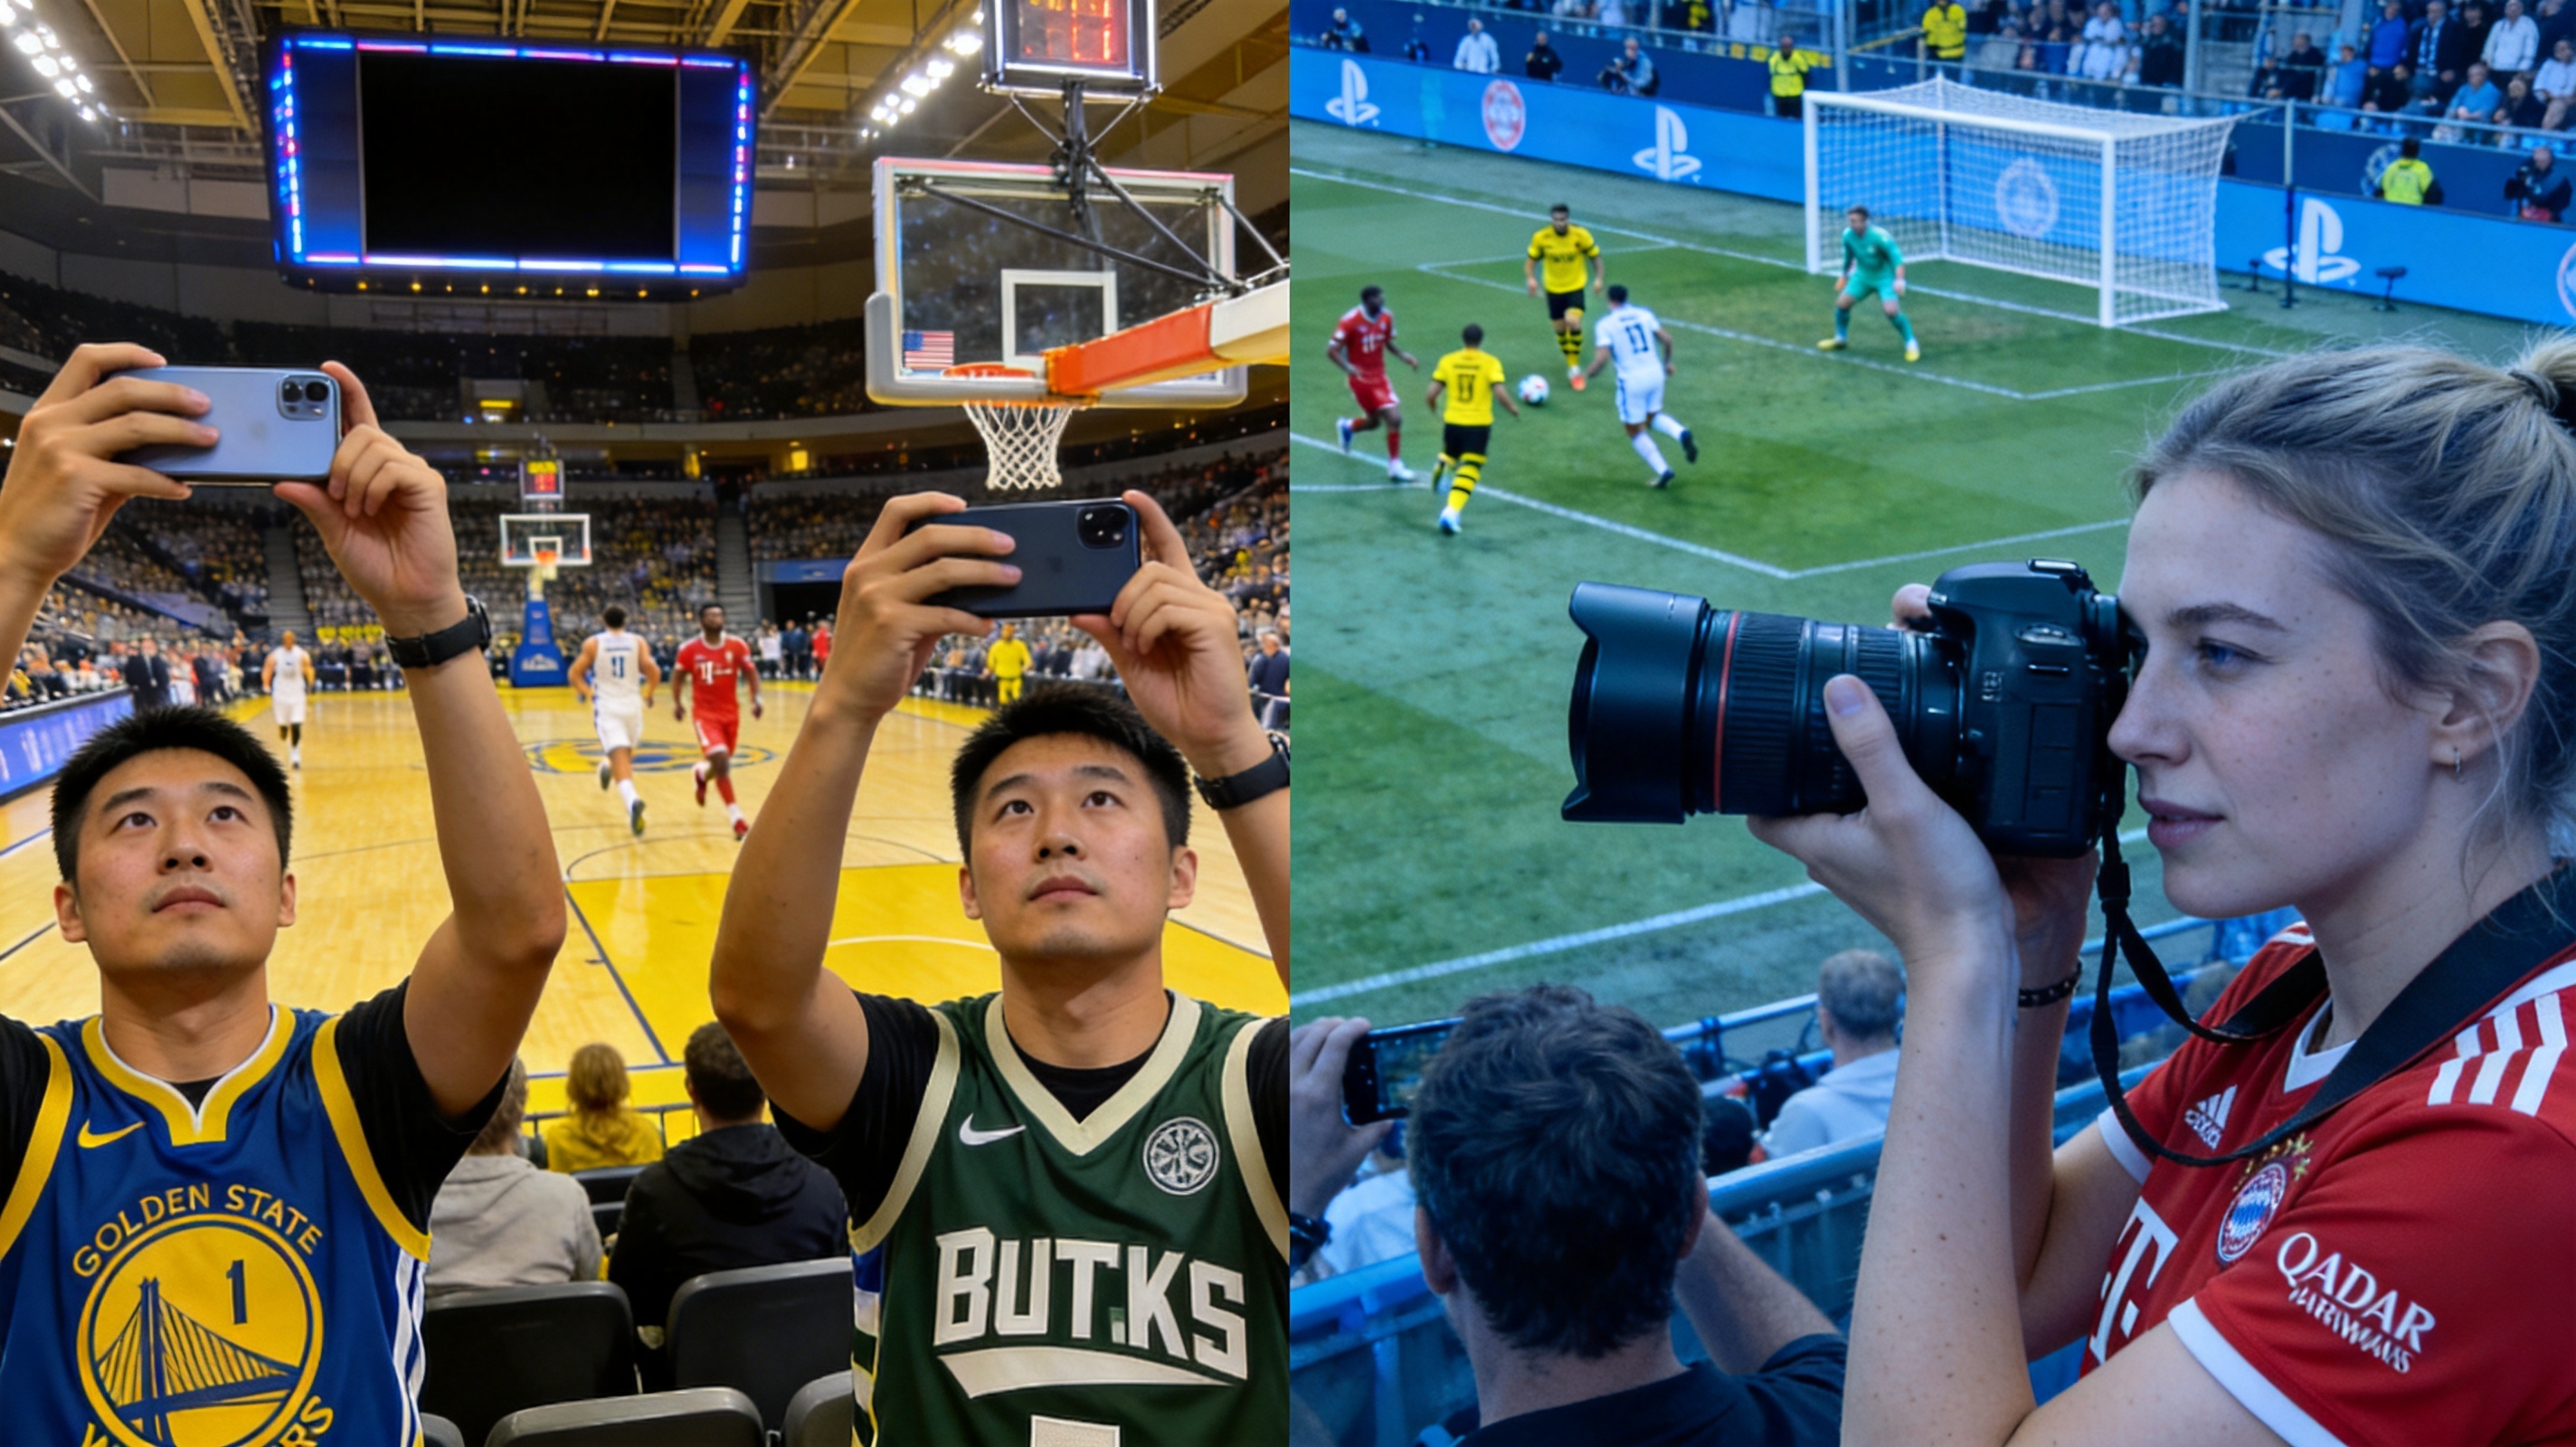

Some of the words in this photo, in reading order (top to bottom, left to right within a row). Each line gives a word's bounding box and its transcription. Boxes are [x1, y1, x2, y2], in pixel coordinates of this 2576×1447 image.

[72, 1183, 210, 1276] GOLDEN
[225, 1184, 323, 1254] STATE
[226, 1259, 248, 1325] 1
[2277, 1232, 2437, 1354] QADAR
